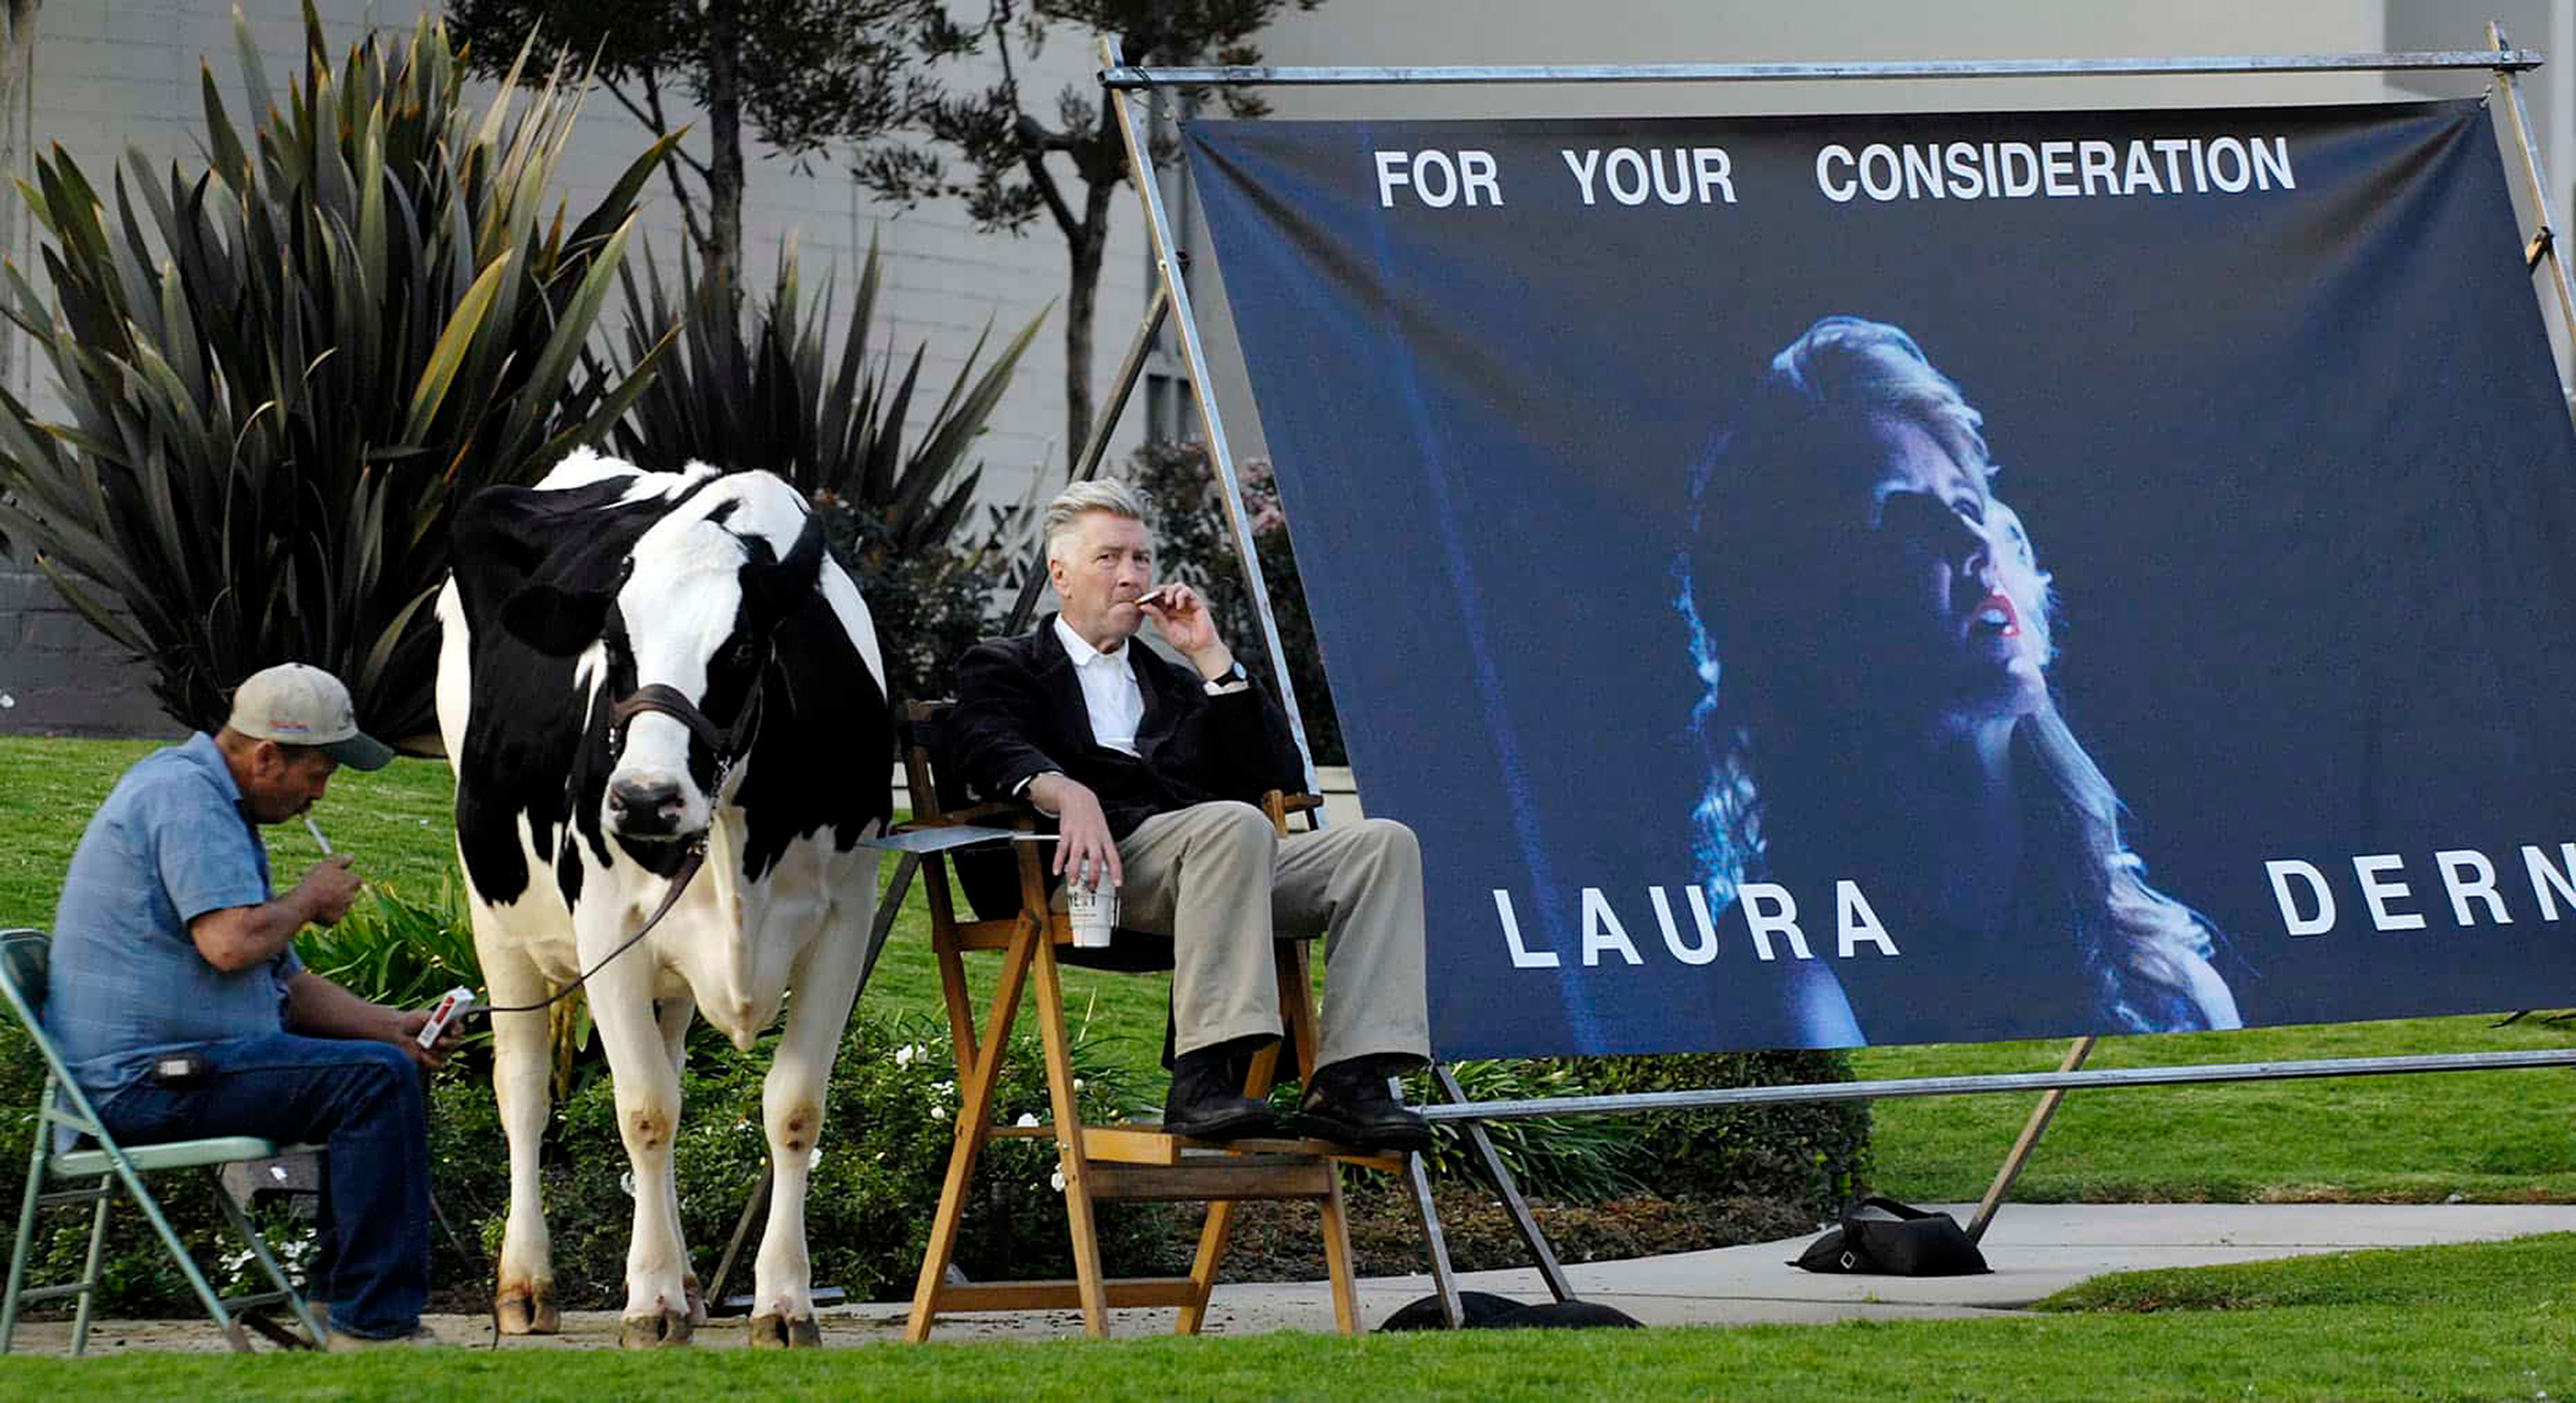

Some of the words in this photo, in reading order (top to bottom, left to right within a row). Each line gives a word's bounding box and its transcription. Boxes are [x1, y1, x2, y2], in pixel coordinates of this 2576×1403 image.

[1374, 149, 1504, 208] FOR
[1561, 147, 1738, 205] YOUR
[1816, 136, 2296, 202] CONSIDERATION
[1492, 880, 1900, 968] LAURA
[2264, 842, 2576, 936] DERN
